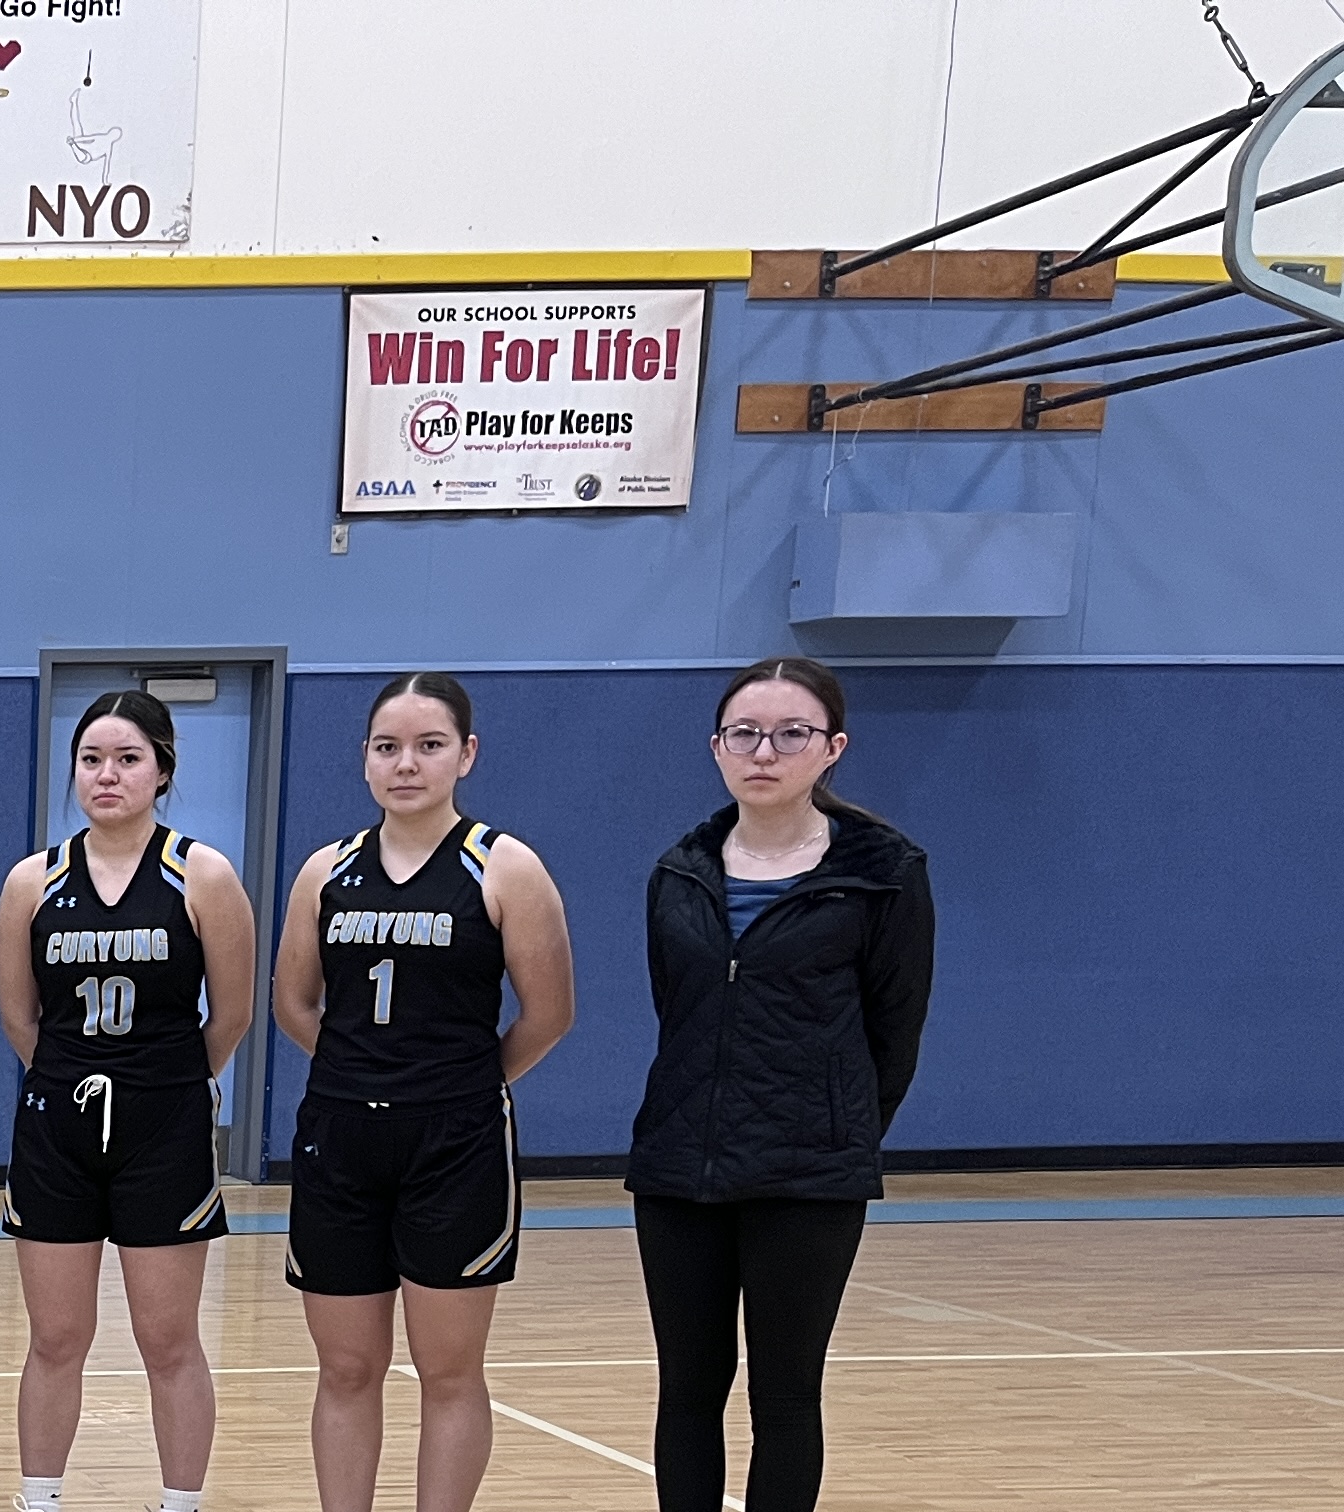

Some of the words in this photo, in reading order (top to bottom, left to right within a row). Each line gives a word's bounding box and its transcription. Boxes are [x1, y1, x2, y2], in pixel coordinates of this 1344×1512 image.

[0, 0, 36, 17] Go
[48, 0, 121, 23] Fight!
[27, 184, 151, 239] NYO
[418, 307, 456, 322] OUR
[464, 306, 537, 322] SCHOOL
[544, 305, 637, 321] SUPPORTS
[368, 332, 465, 386] Win
[480, 330, 559, 383] For
[572, 328, 681, 382] Life!
[415, 416, 458, 438] TAD
[465, 410, 516, 438] Play
[521, 410, 555, 435] for
[559, 409, 633, 436] Keeps
[463, 439, 632, 453] www.playforkeepsalaska.org
[356, 480, 417, 497] ASAA
[445, 480, 498, 489] PROVIDENCE
[326, 910, 453, 947] CURYUNG
[45, 928, 169, 964] CURYUNG
[75, 975, 136, 1036] 10
[368, 958, 395, 1025] 1
